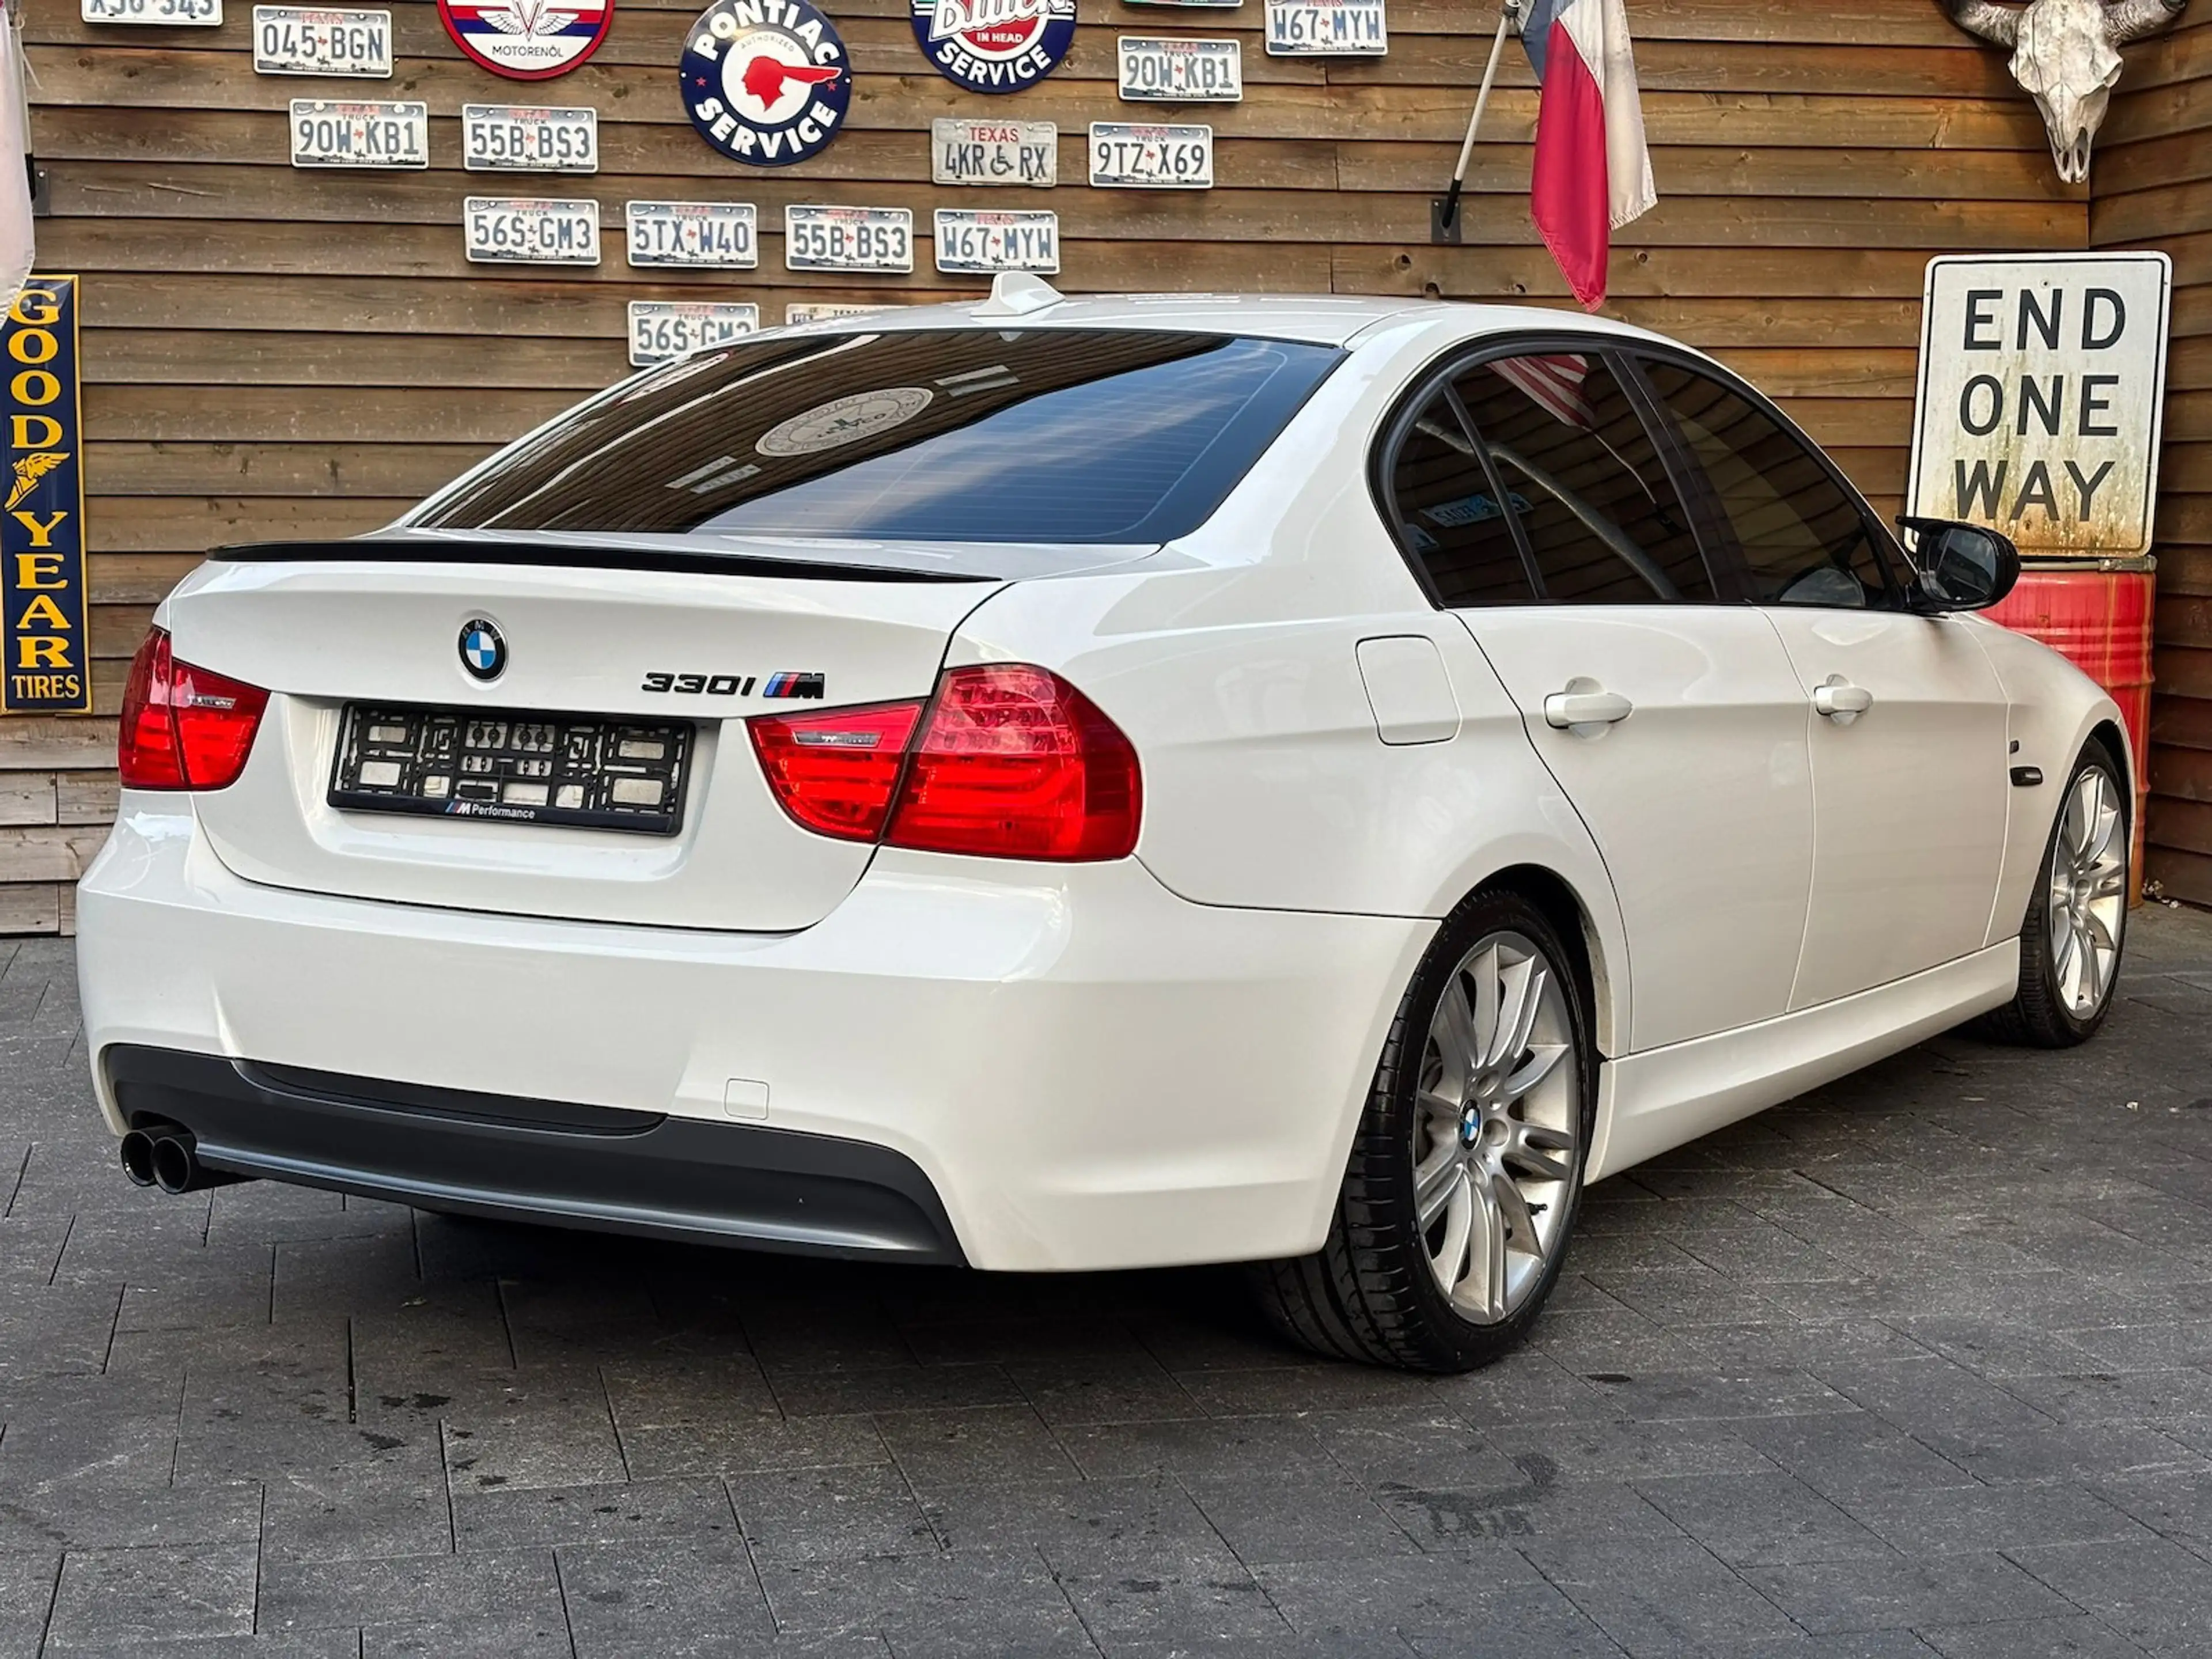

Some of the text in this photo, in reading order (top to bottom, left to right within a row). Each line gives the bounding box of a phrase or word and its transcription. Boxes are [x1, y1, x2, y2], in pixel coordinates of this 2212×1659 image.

[693, 0, 840, 65] PONTIAC
[741, 35, 794, 52] AUTHORIZED
[977, 32, 1024, 43] IN HEAD
[936, 42, 1052, 85] SERVICE
[695, 97, 838, 158] SERVICE
[969, 127, 1019, 142] TEXAS
[1964, 288, 2126, 350] END
[1959, 374, 2119, 436] ONE
[1955, 459, 2116, 522] WAY
[11, 675, 80, 699] TIRES
[472, 804, 536, 819] Performance
